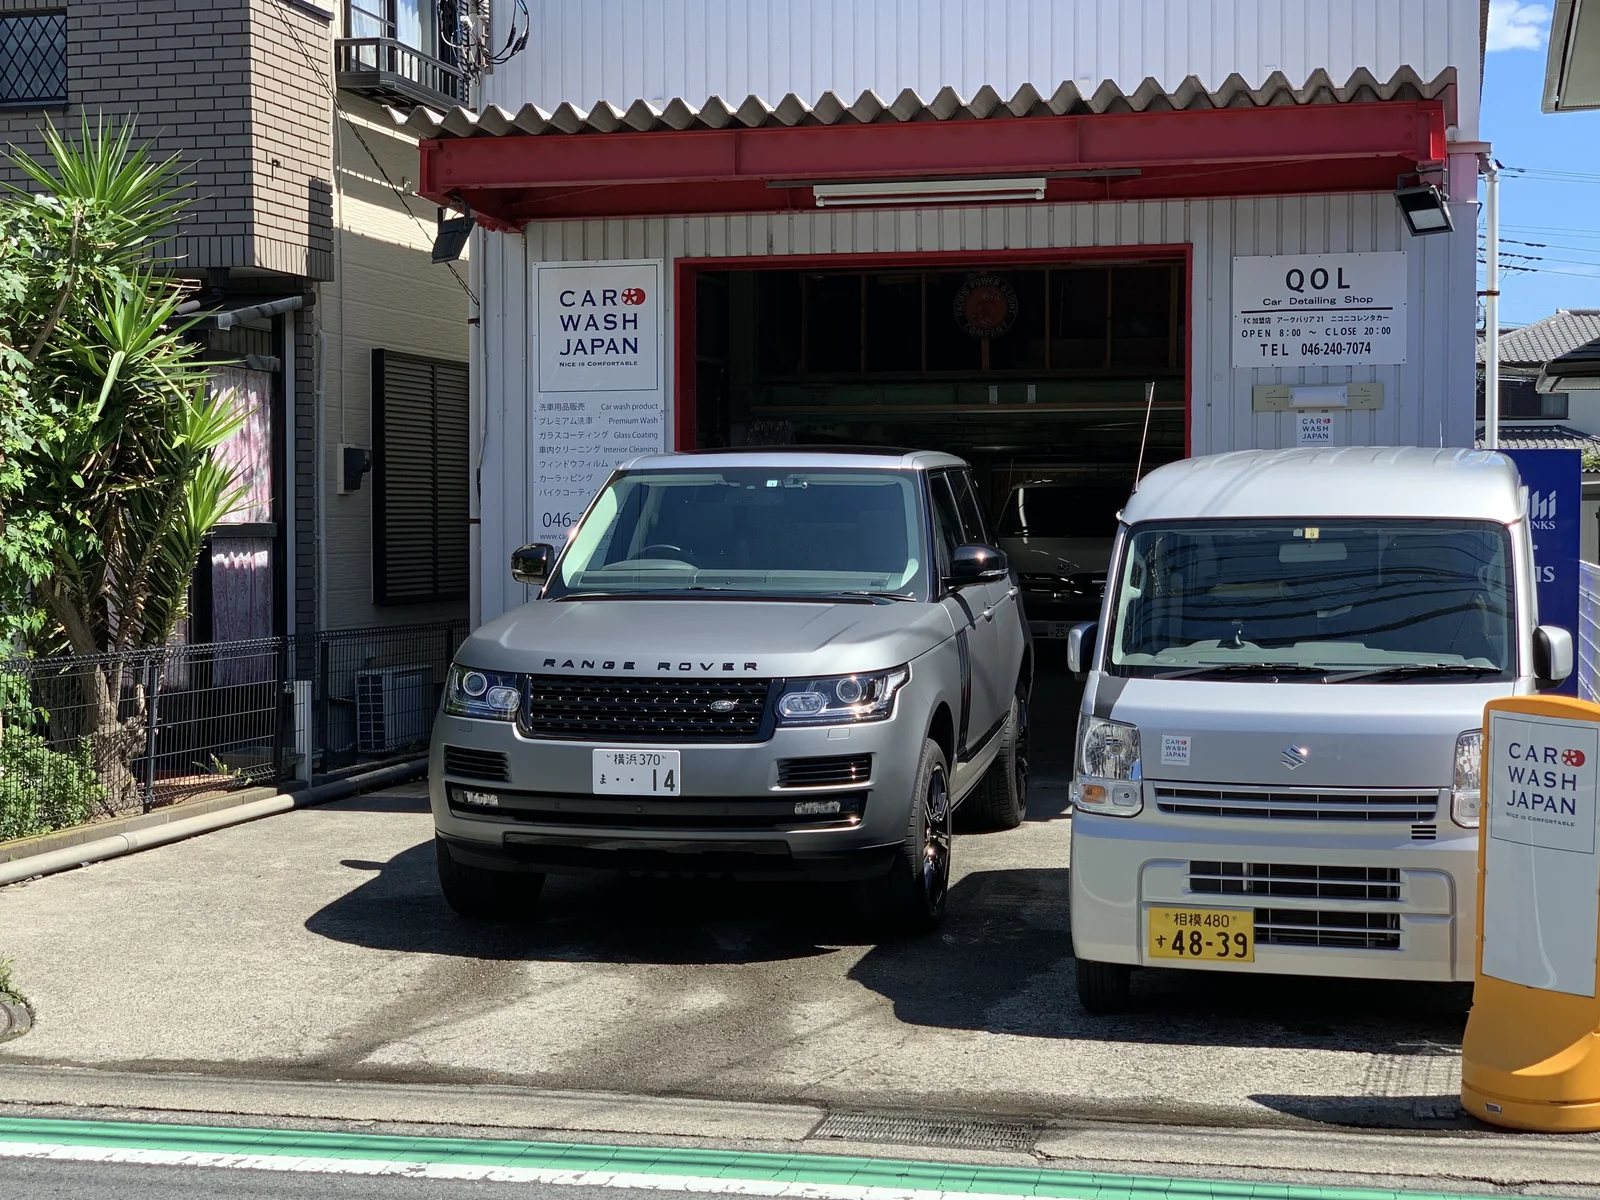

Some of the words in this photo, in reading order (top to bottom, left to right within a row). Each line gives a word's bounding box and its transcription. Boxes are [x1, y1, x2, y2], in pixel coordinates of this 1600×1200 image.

[1286, 267, 1350, 293] QOL
[560, 289, 617, 307] CAR
[969, 276, 1001, 289] POWER
[1005, 291, 1017, 314] LIGHT
[1263, 298, 1283, 306] Car
[1289, 296, 1337, 306] Detailing
[1344, 295, 1374, 304] Shop
[559, 312, 638, 332] WASH
[1330, 314, 1389, 322] ニコニコレンタカー
[964, 320, 1008, 338] COMPANY
[1241, 329, 1271, 338] OPEN
[1279, 328, 1301, 338] 8:00
[1325, 326, 1357, 336] CLOSE
[1364, 326, 1391, 336] 20:00
[559, 338, 638, 356] JAPAN
[1260, 343, 1289, 356] TEL
[1301, 341, 1372, 356] 046-240-7074
[539, 402, 586, 412] 洗車用品販売
[611, 402, 631, 410] wash
[631, 403, 658, 412] product
[539, 416, 593, 426] プレミアム洗車
[608, 417, 640, 425] Premium
[640, 417, 658, 425] Wash
[538, 430, 609, 440] ガラスコーティング
[632, 431, 658, 440] Coating
[538, 444, 601, 455] 車内クリーニング
[603, 446, 628, 454] Interior
[628, 446, 658, 455] Cleaning
[539, 460, 609, 469] ウィンドウフィルム
[539, 474, 593, 483] カーラッピング
[539, 488, 597, 497] バイクコーティ
[1528, 490, 1556, 520] hi
[1530, 520, 1556, 530] NKS
[1055, 628, 1070, 638] 25-
[543, 658, 636, 670] RANGE
[657, 661, 758, 671] ROVER
[1508, 742, 1558, 765] CAR
[599, 773, 607, 785] ま
[1507, 765, 1577, 792] WASH
[1506, 790, 1577, 815] JAPAN
[1155, 934, 1168, 949] す
[1171, 929, 1248, 958] 48-39
